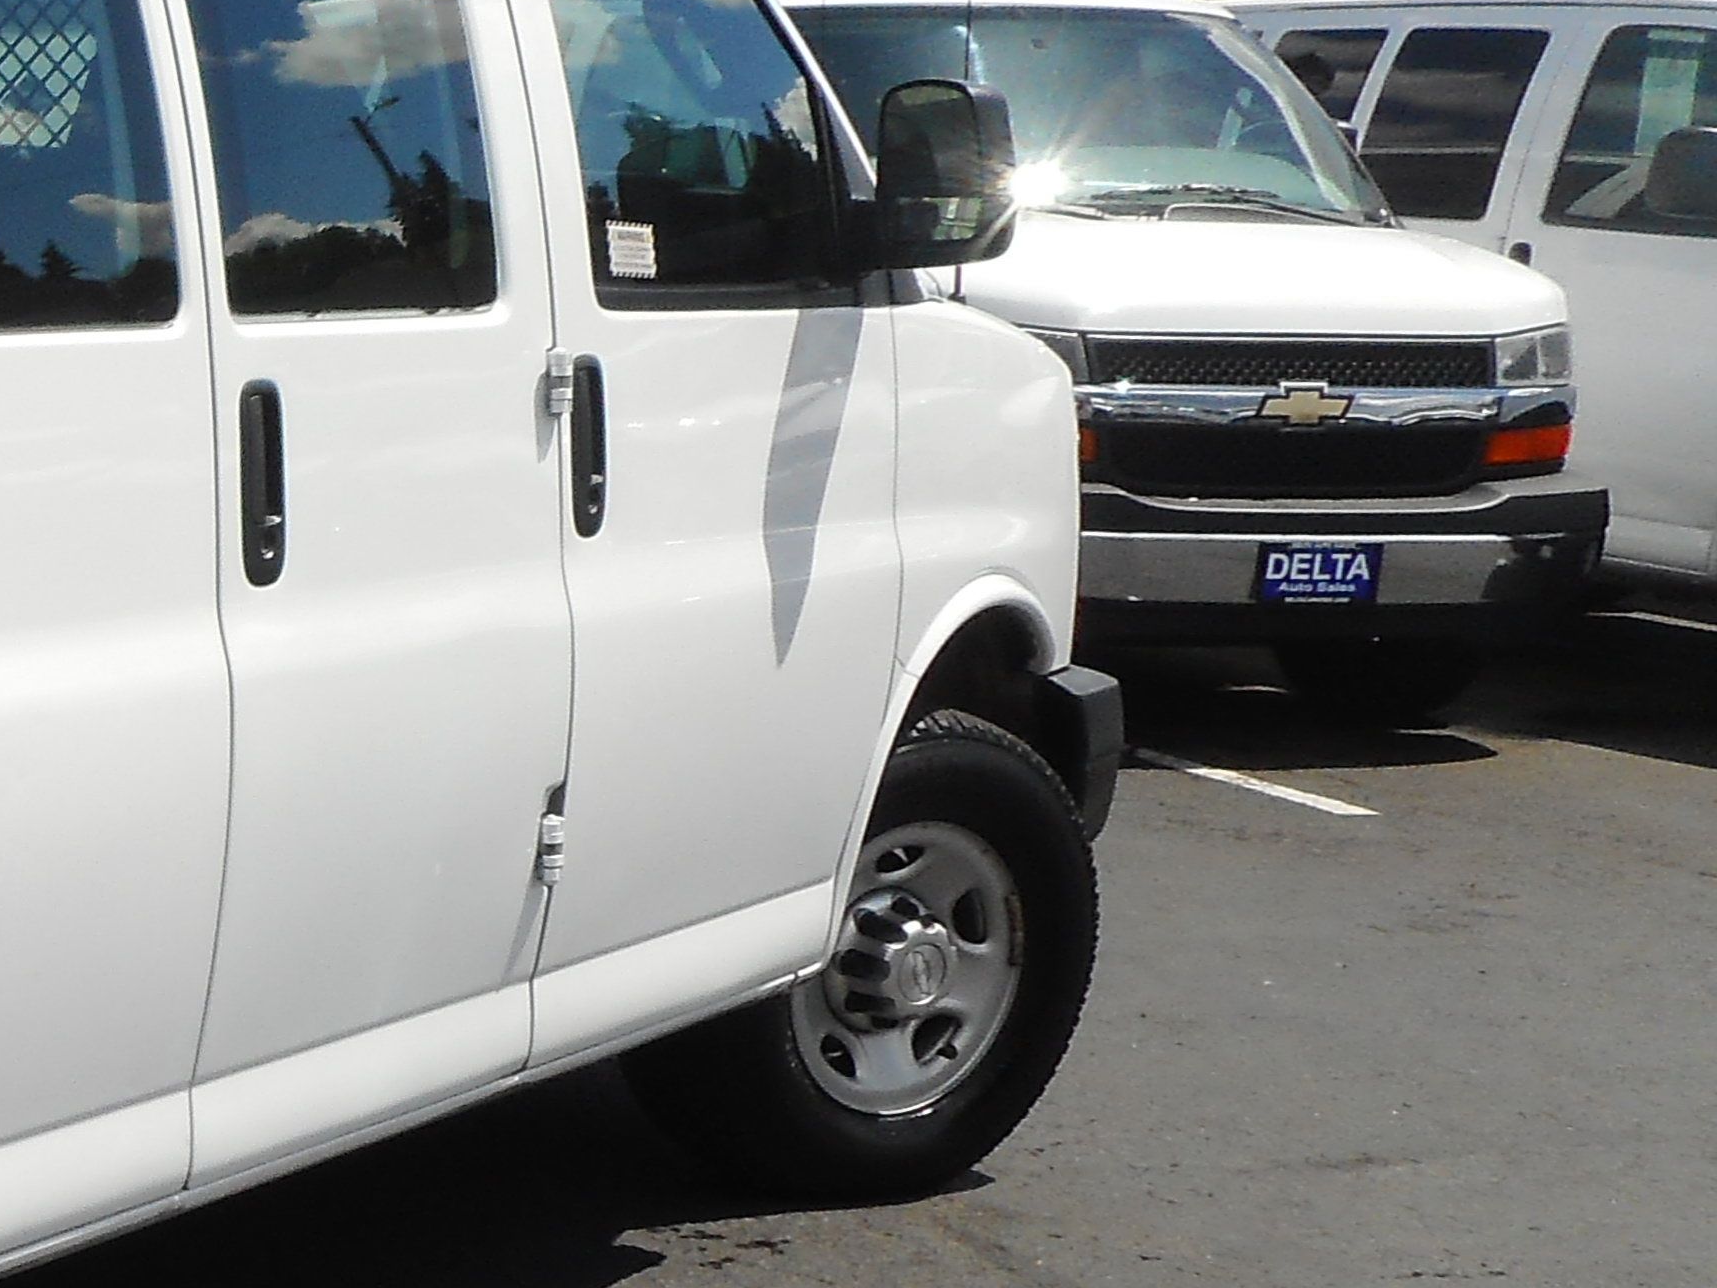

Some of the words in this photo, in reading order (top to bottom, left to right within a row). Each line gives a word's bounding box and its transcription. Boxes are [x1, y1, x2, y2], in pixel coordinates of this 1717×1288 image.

[1265, 553, 1371, 580] DELTA
[1279, 581, 1314, 593] Auto
[1316, 581, 1356, 593] Sales
